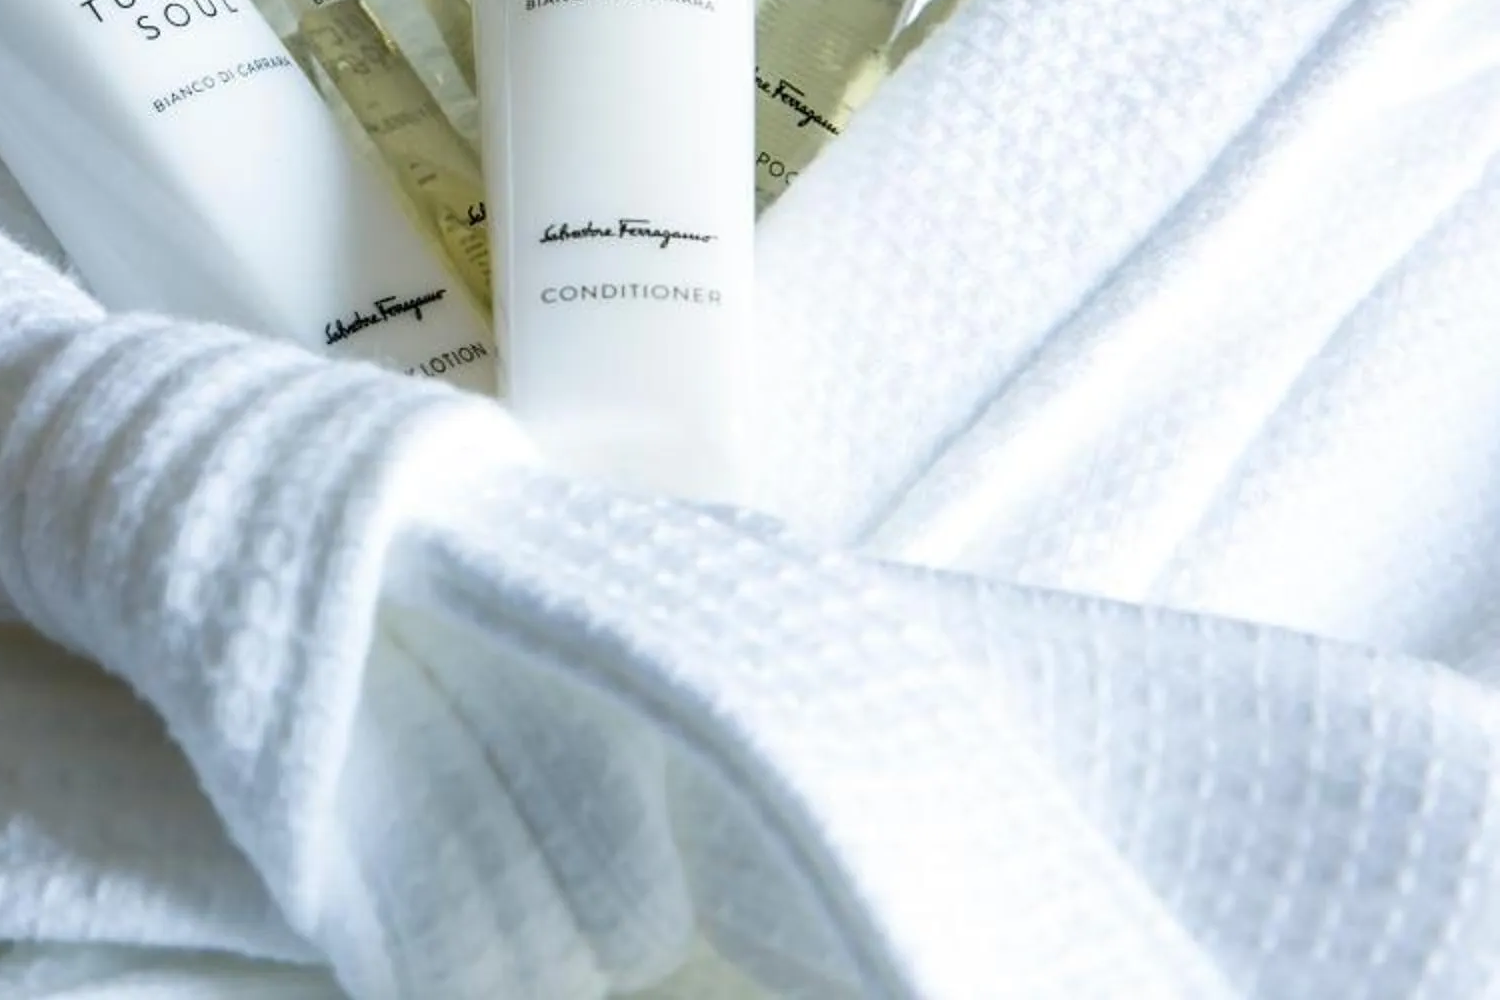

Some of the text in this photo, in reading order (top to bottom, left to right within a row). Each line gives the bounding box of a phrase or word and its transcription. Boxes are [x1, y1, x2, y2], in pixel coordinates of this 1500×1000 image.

[152, 75, 216, 113] BIANCO
[218, 69, 235, 84] DI
[540, 283, 722, 305] CONDITIONER
[420, 342, 487, 377] LOTION
